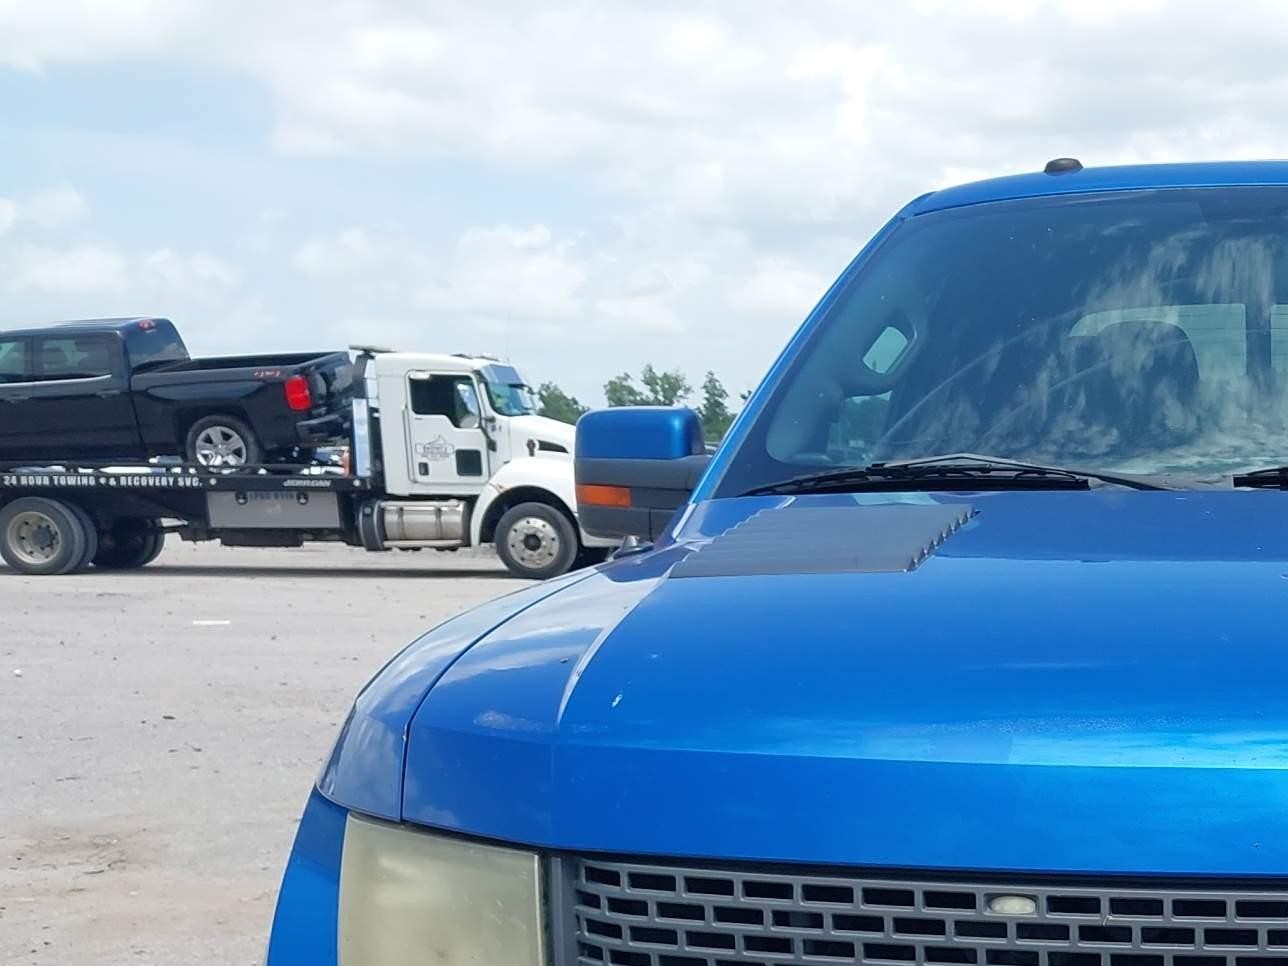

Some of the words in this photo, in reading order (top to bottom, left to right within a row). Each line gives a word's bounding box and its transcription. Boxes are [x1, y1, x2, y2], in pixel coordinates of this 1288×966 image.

[3, 475, 17, 486] 24
[21, 475, 50, 486] HOUR
[53, 475, 96, 486] TOWING
[120, 475, 175, 487] RECOVERY
